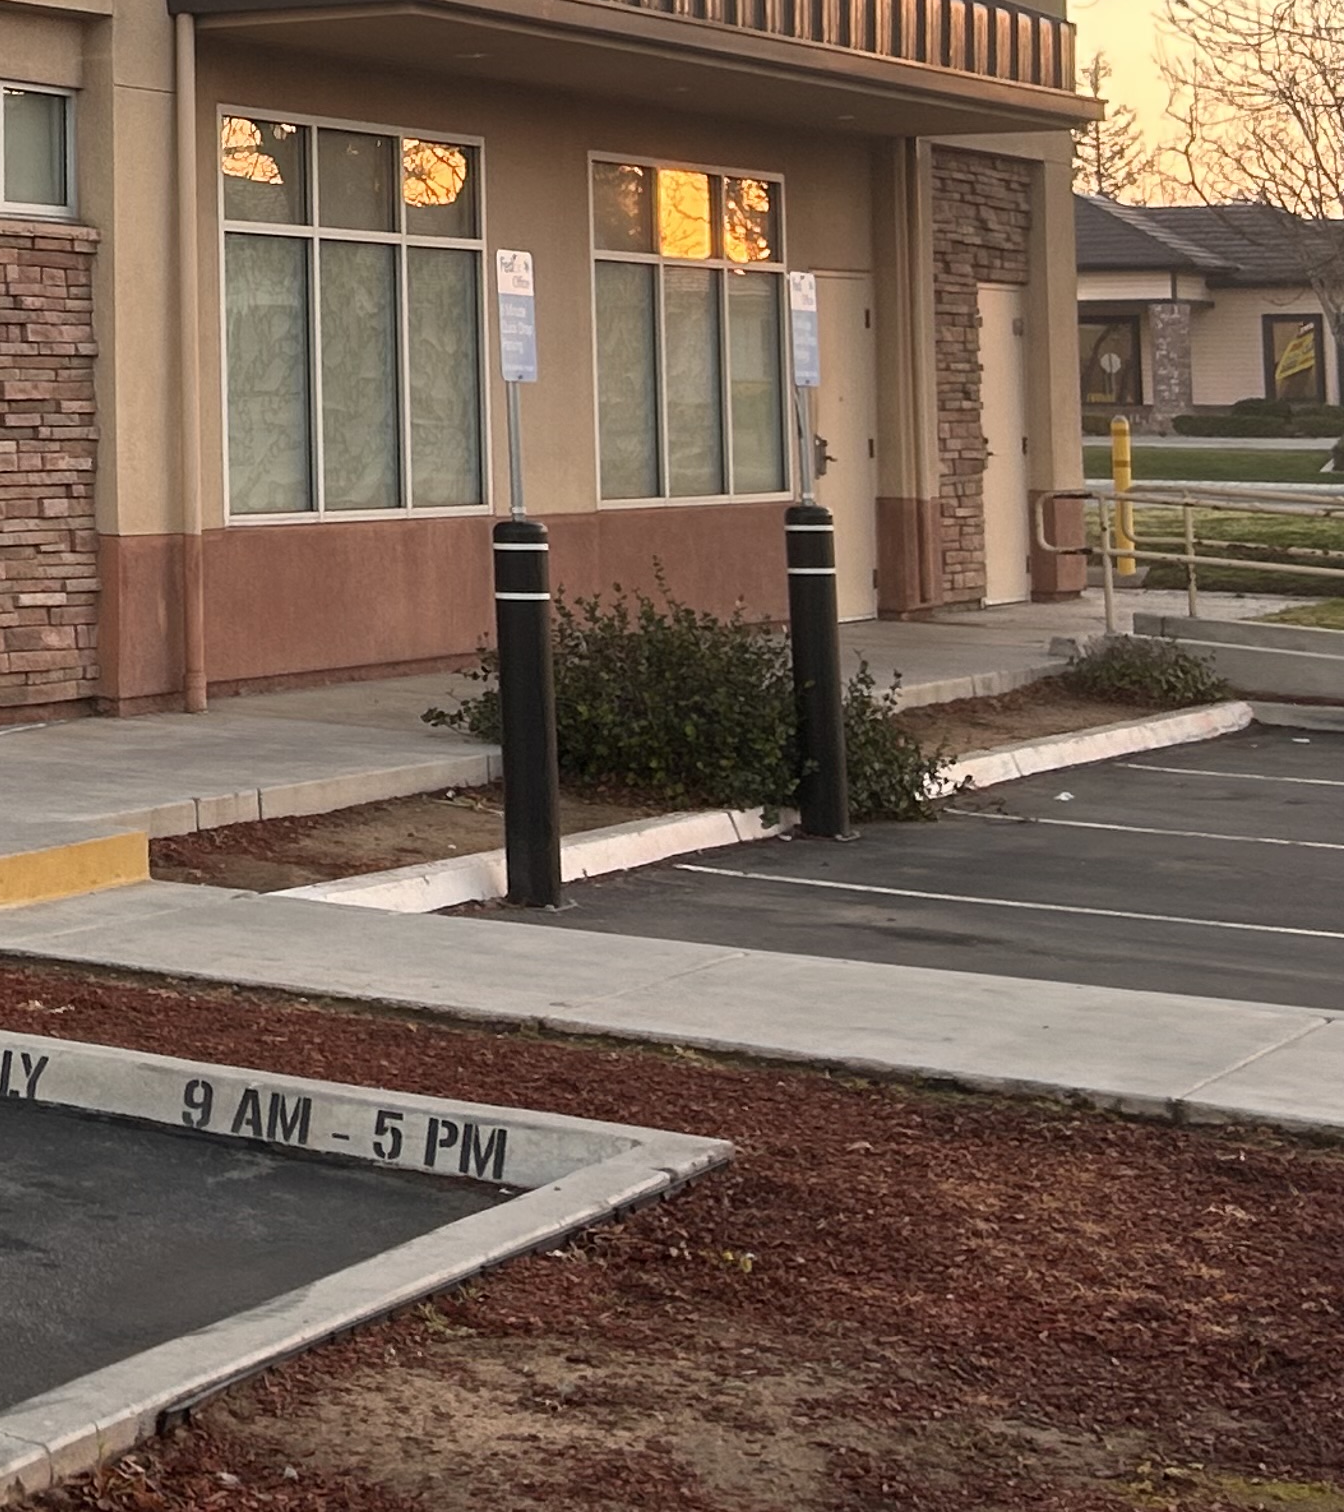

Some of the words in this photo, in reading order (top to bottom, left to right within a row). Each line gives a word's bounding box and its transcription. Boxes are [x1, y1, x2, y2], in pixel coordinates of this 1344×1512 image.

[181, 1078, 214, 1130] 9
[230, 1087, 313, 1146] AM
[372, 1108, 404, 1161] 5
[423, 1116, 509, 1181] PM
